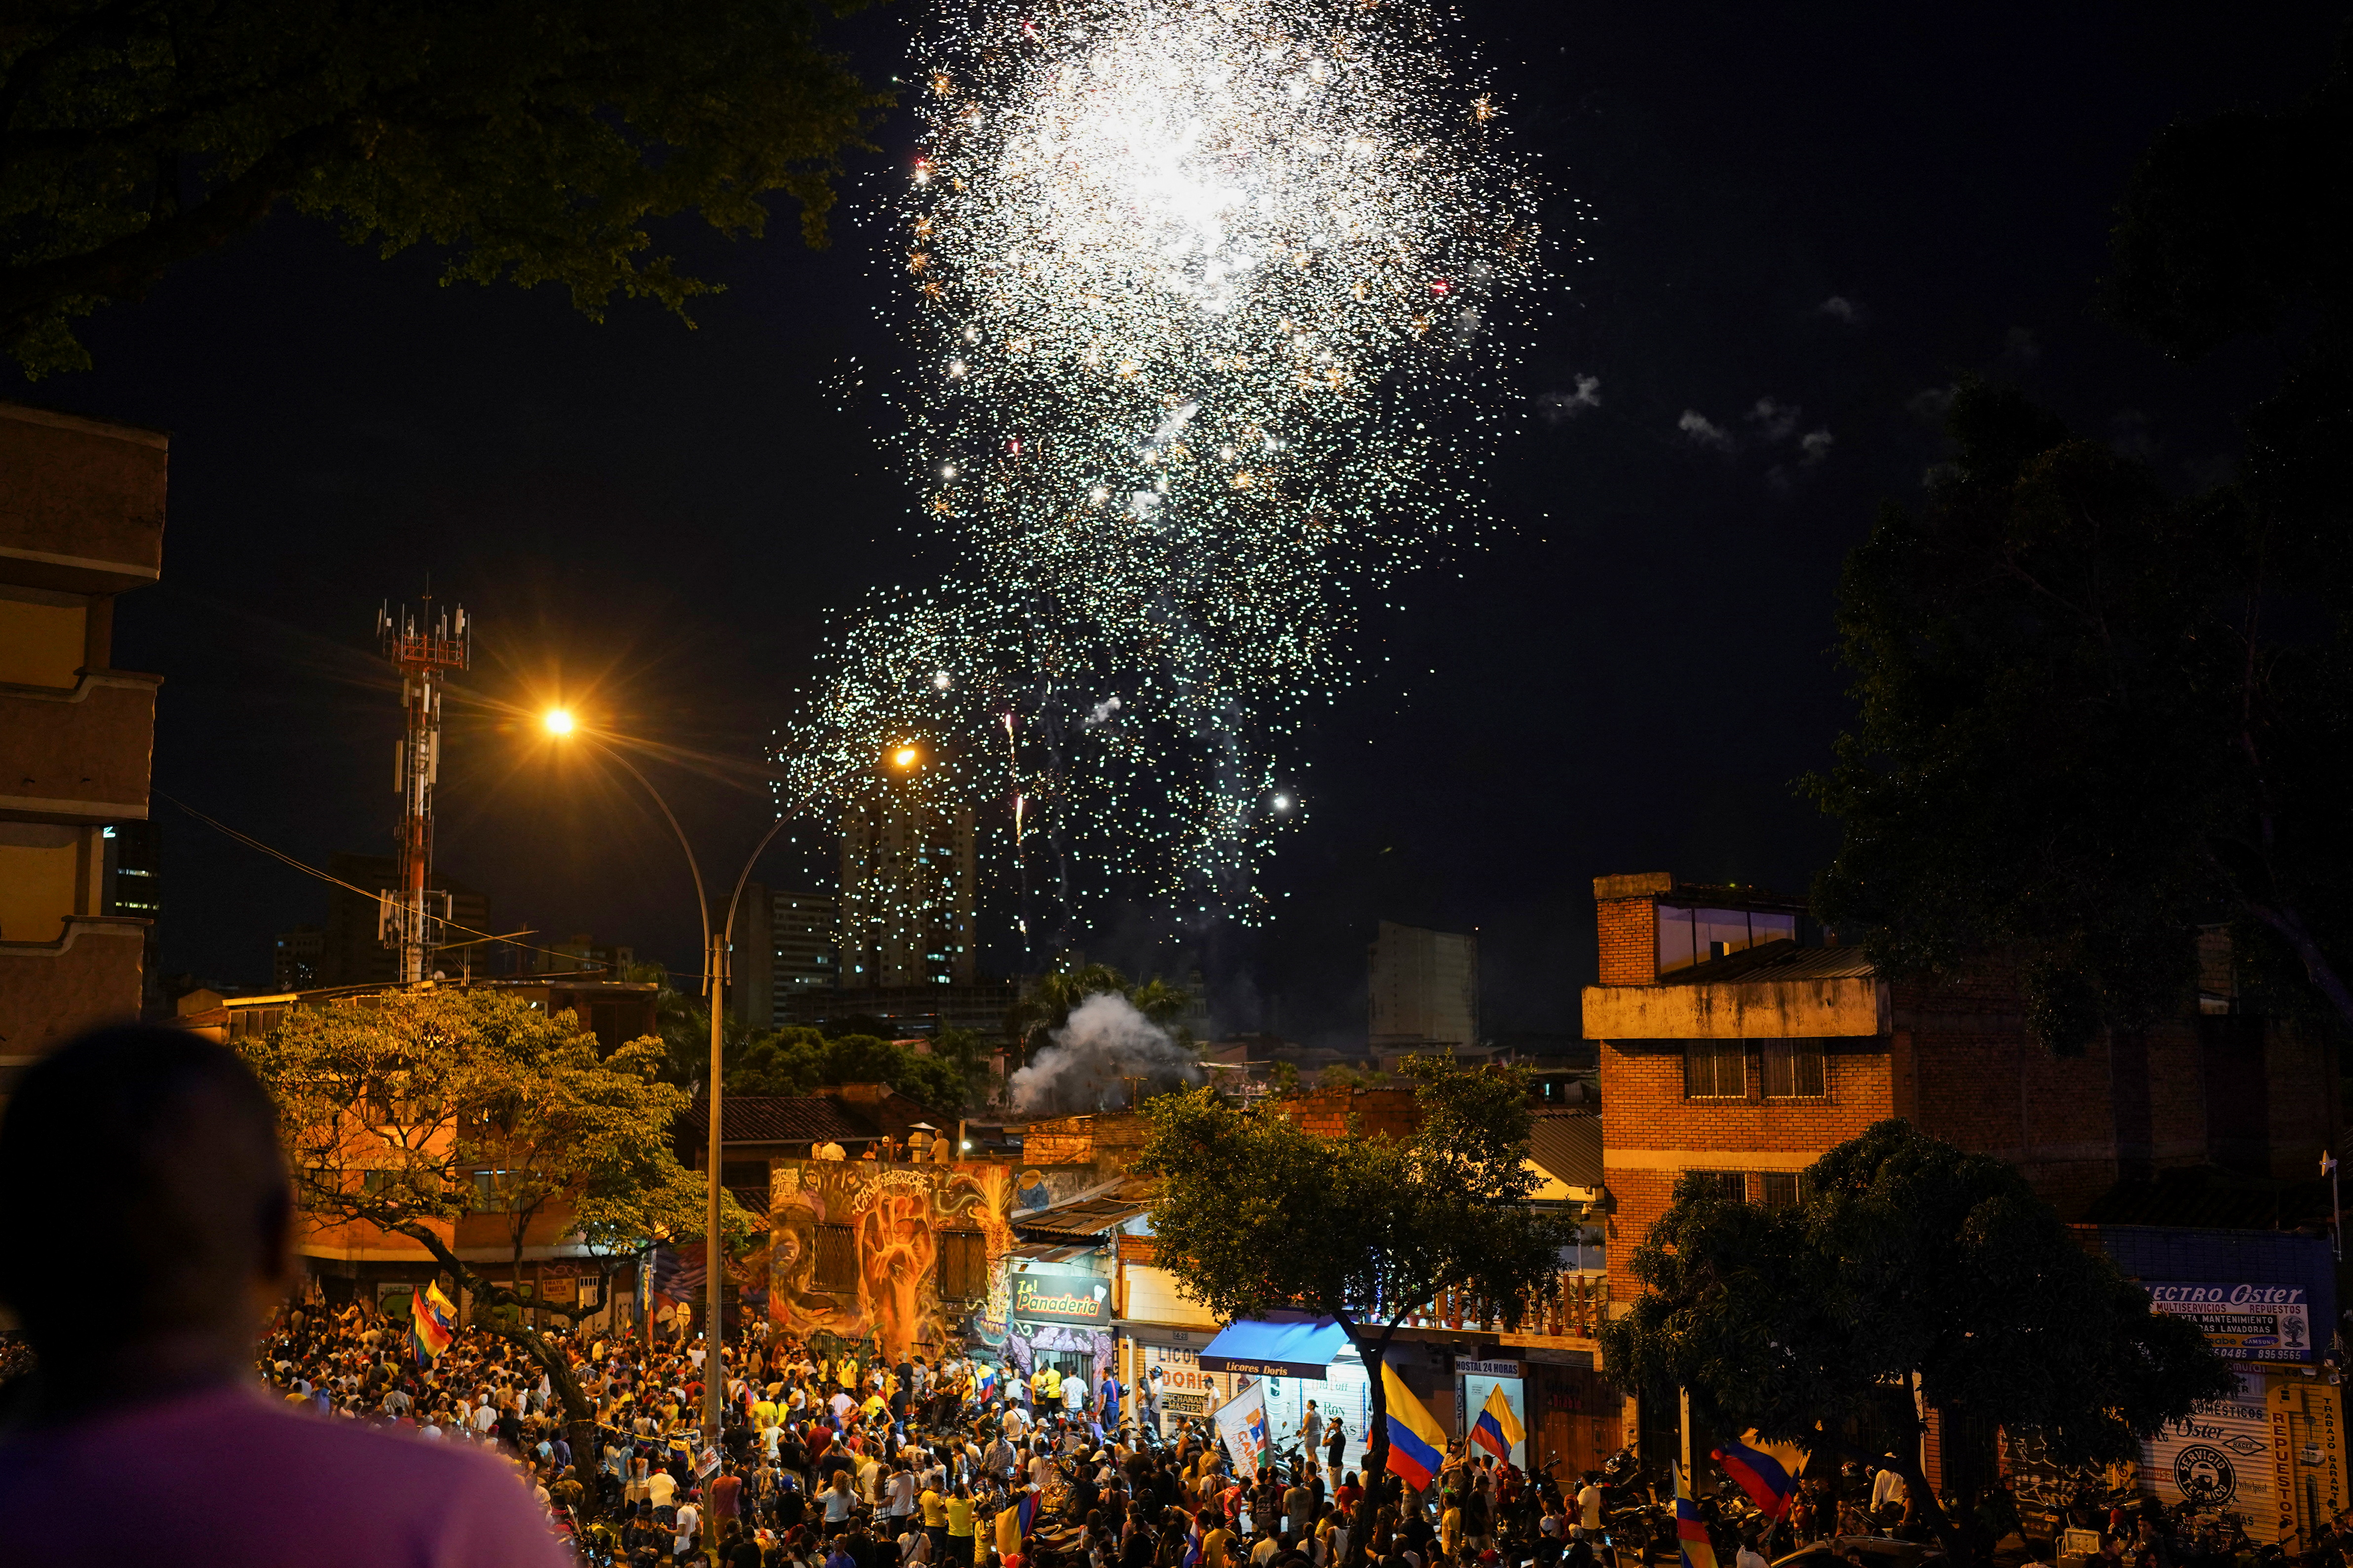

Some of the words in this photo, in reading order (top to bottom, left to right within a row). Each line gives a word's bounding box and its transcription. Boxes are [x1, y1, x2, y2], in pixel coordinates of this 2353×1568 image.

[2145, 1286, 2223, 1302] ECTRO
[2230, 1284, 2304, 1305] Oster
[2156, 1303, 2227, 1313] MULTISERVICIOS
[2249, 1305, 2301, 1314] REPUESTOS
[2201, 1314, 2274, 1324] MANTENIMIENTO
[2220, 1325, 2271, 1333] LAVADORAS
[2211, 1336, 2237, 1345] abe
[2213, 1348, 2247, 1358] 50485
[2258, 1349, 2301, 1360] 8959565
[1226, 1362, 1259, 1374] Licores
[1263, 1365, 1288, 1376] Doris
[1456, 1361, 1481, 1372] HOSTAL
[1483, 1363, 1492, 1372] 24
[1493, 1364, 1518, 1375] HORAS
[1168, 1401, 1203, 1413] MASTER
[2192, 1402, 2263, 1419] OMESTICOS
[2175, 1418, 2224, 1439] Oster
[2323, 1398, 2336, 1450] TRABAJO
[2180, 1450, 2226, 1472] SERVICIO
[2272, 1412, 2293, 1526] REPUESTOS
[2237, 1480, 2267, 1494] Whirlpool
[2328, 1456, 2341, 1515] GARANTIZ
